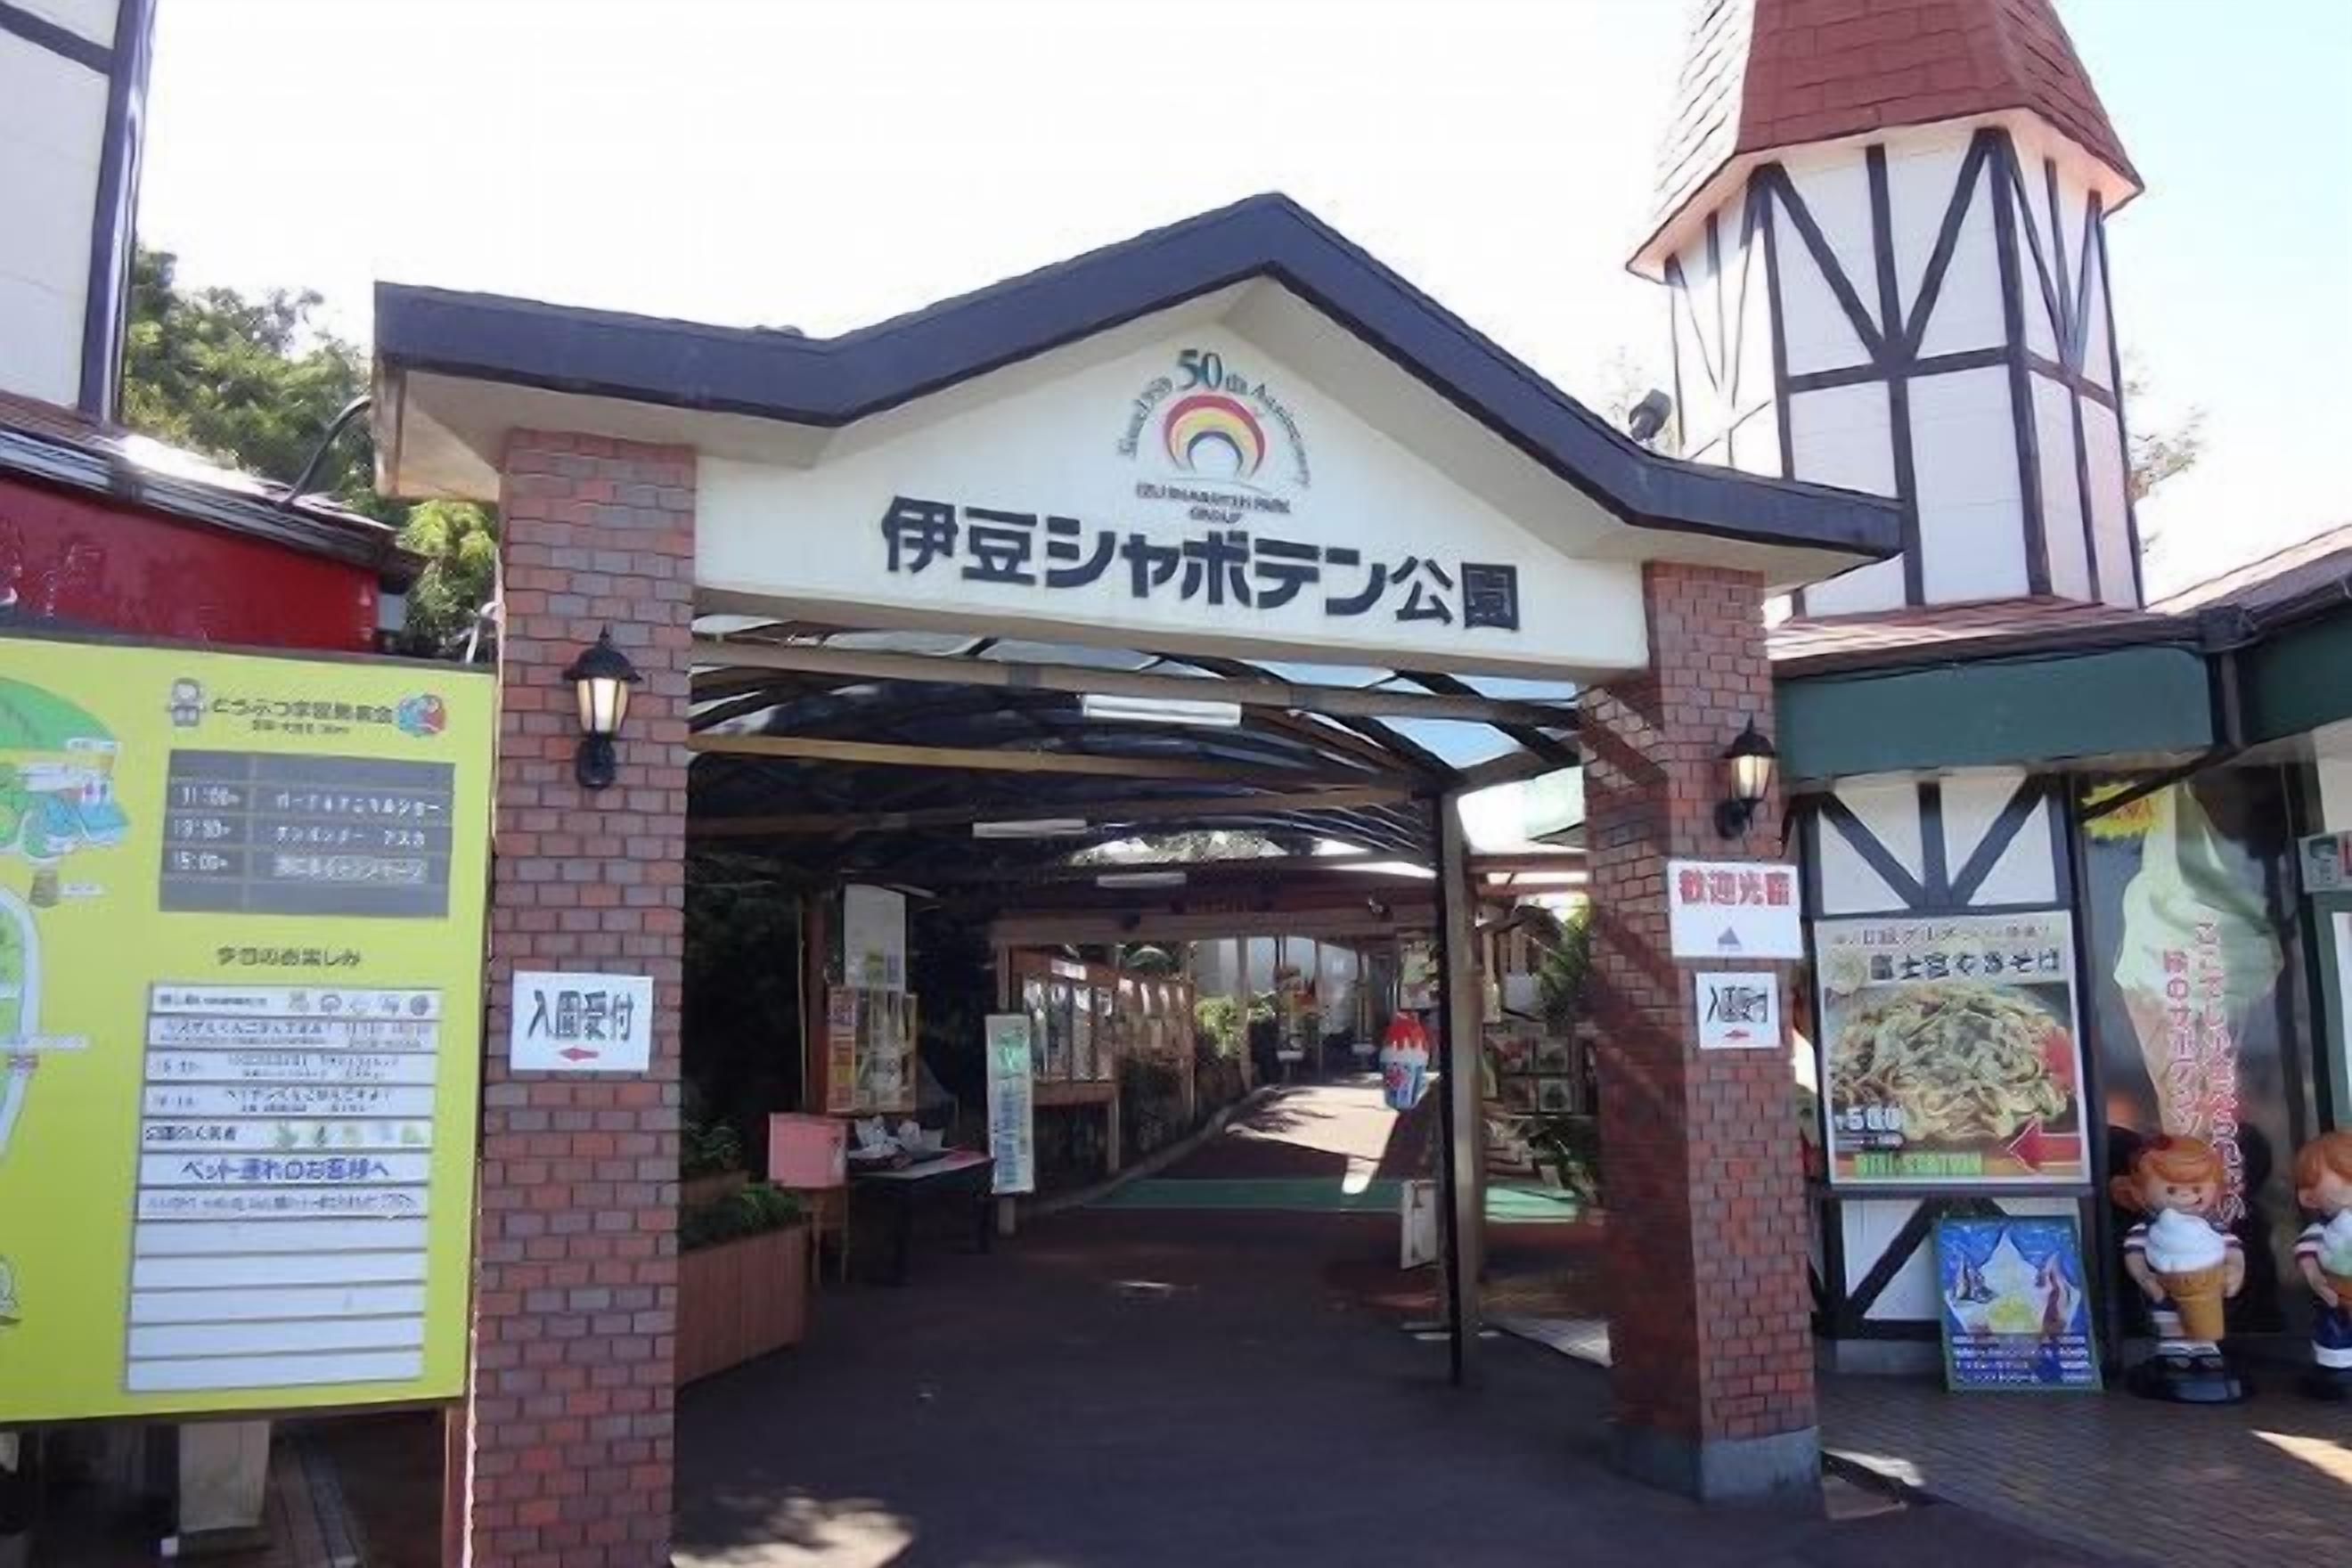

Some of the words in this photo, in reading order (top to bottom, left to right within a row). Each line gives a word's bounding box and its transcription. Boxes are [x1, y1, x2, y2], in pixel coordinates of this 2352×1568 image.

[880, 495, 1520, 632] 伊豆シャボテン公園
